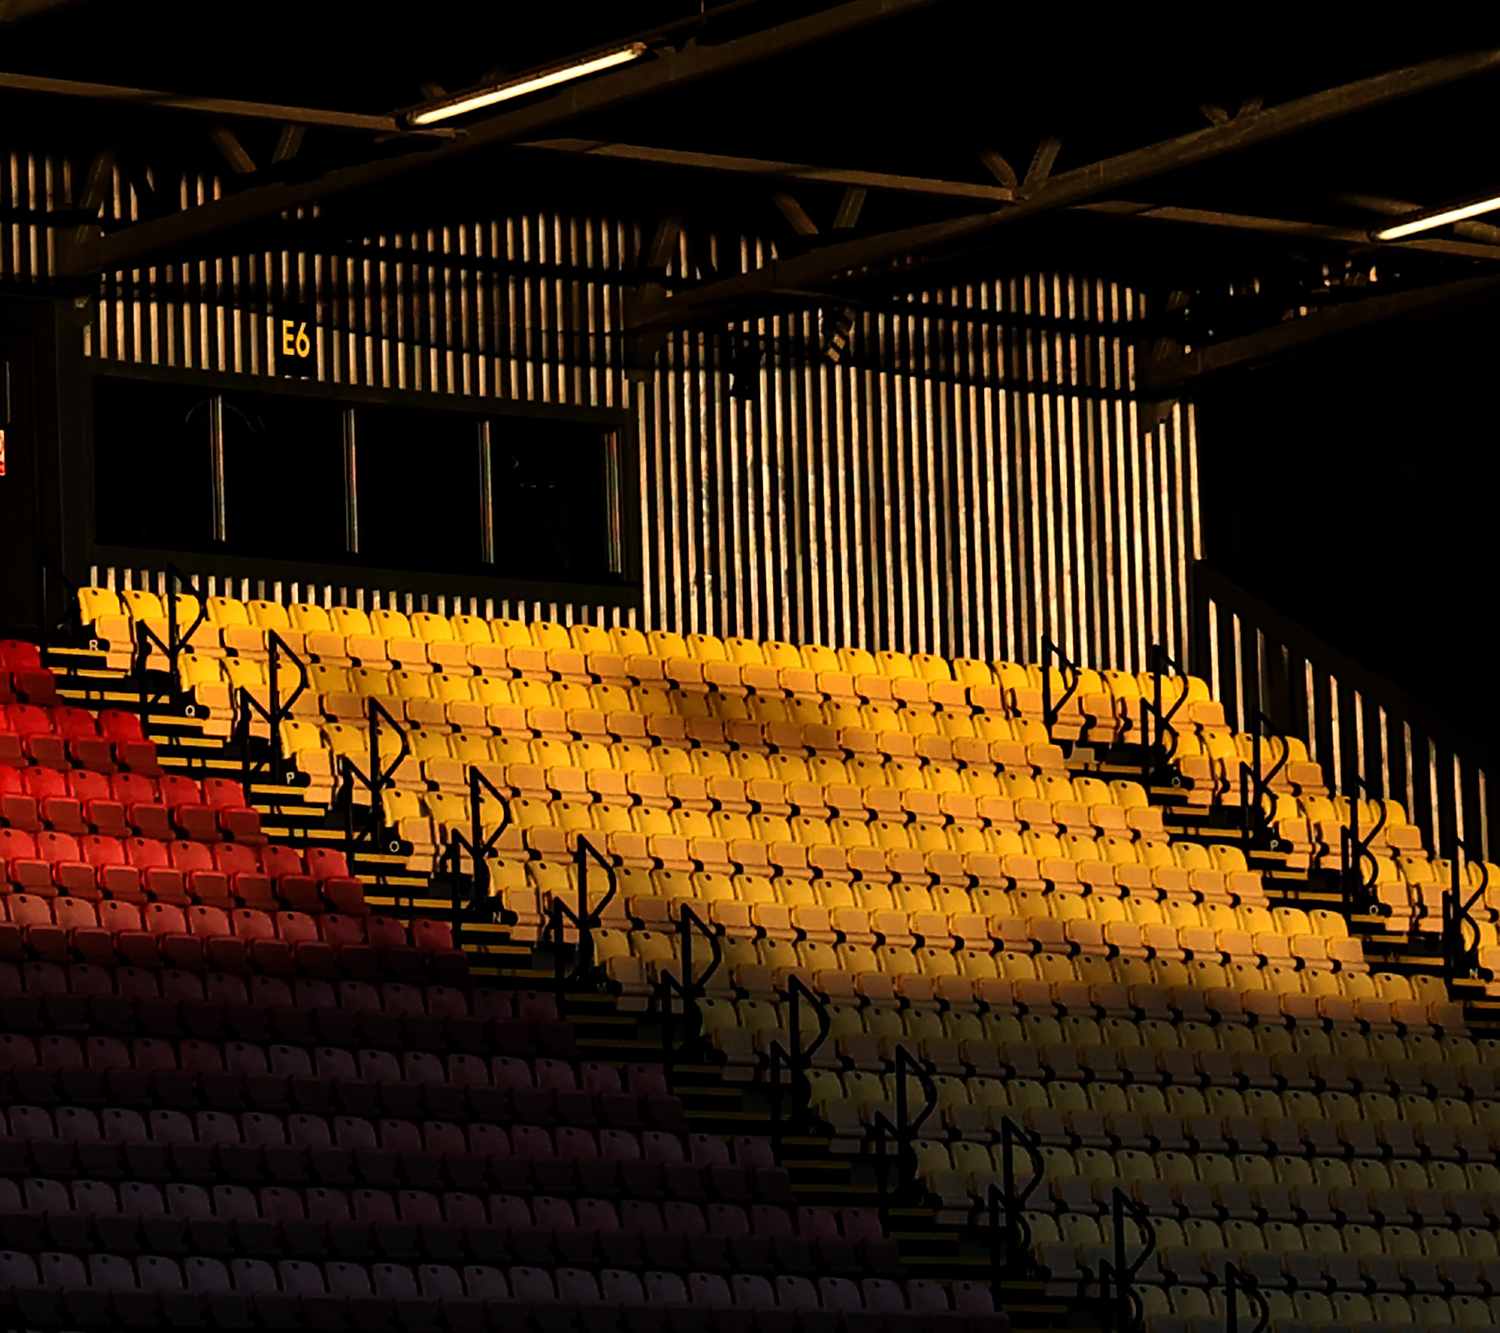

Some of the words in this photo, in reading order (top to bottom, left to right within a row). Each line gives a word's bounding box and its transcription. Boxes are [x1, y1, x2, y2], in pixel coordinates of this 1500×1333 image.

[282, 319, 311, 358] E6
[89, 639, 99, 652] R
[286, 772, 296, 785] P
